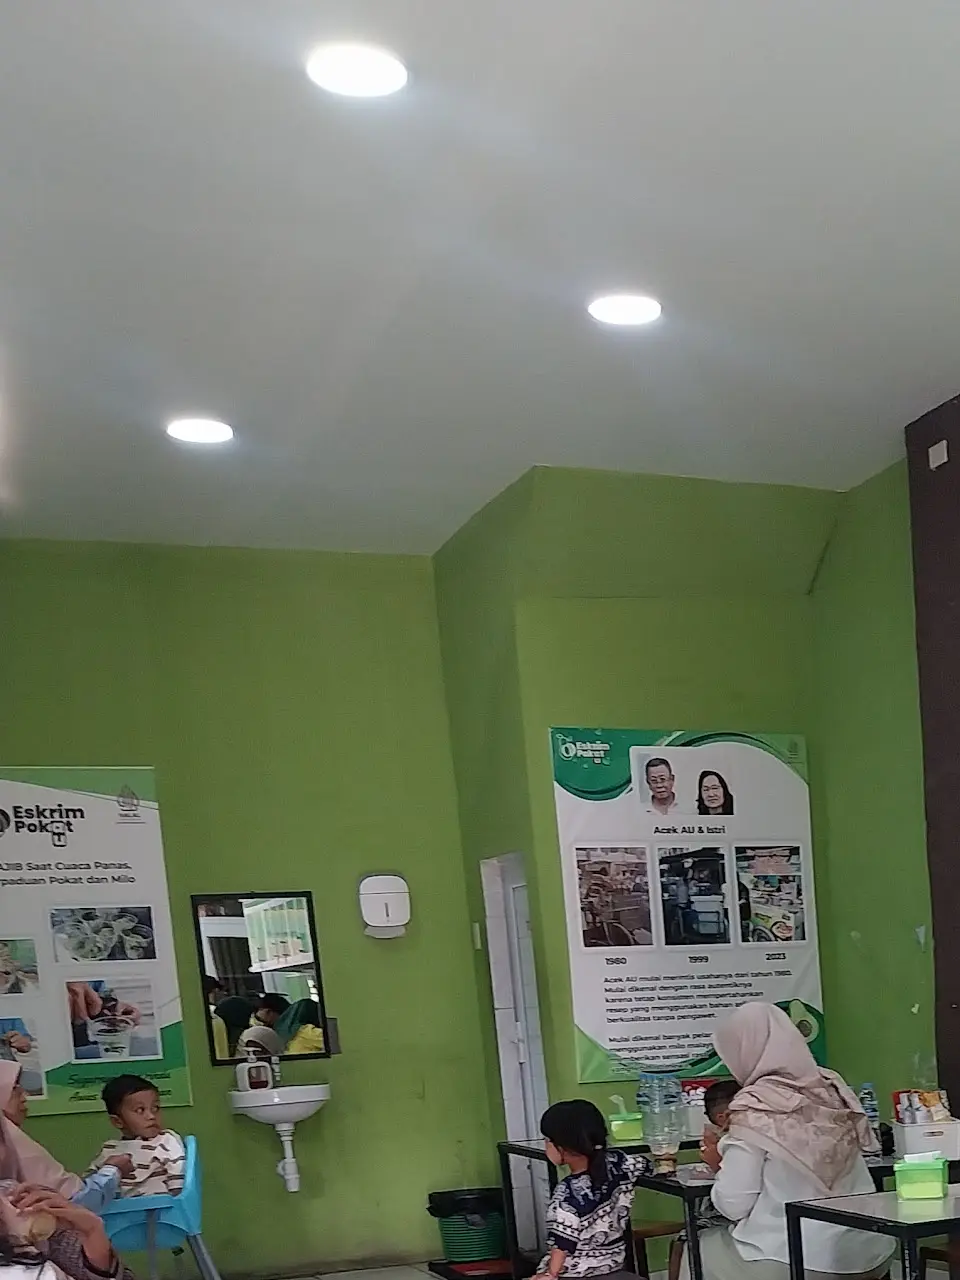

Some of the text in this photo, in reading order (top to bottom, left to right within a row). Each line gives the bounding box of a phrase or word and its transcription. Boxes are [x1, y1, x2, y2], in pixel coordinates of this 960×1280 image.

[12, 803, 85, 819] Eskrim
[653, 825, 679, 834] Acek
[681, 826, 695, 834] AU
[697, 826, 705, 834] &
[26, 862, 53, 870] Saat
[55, 862, 92, 870] Cuaca
[49, 876, 84, 885] Pokat
[86, 875, 108, 883] dan
[111, 874, 136, 884] Milo
